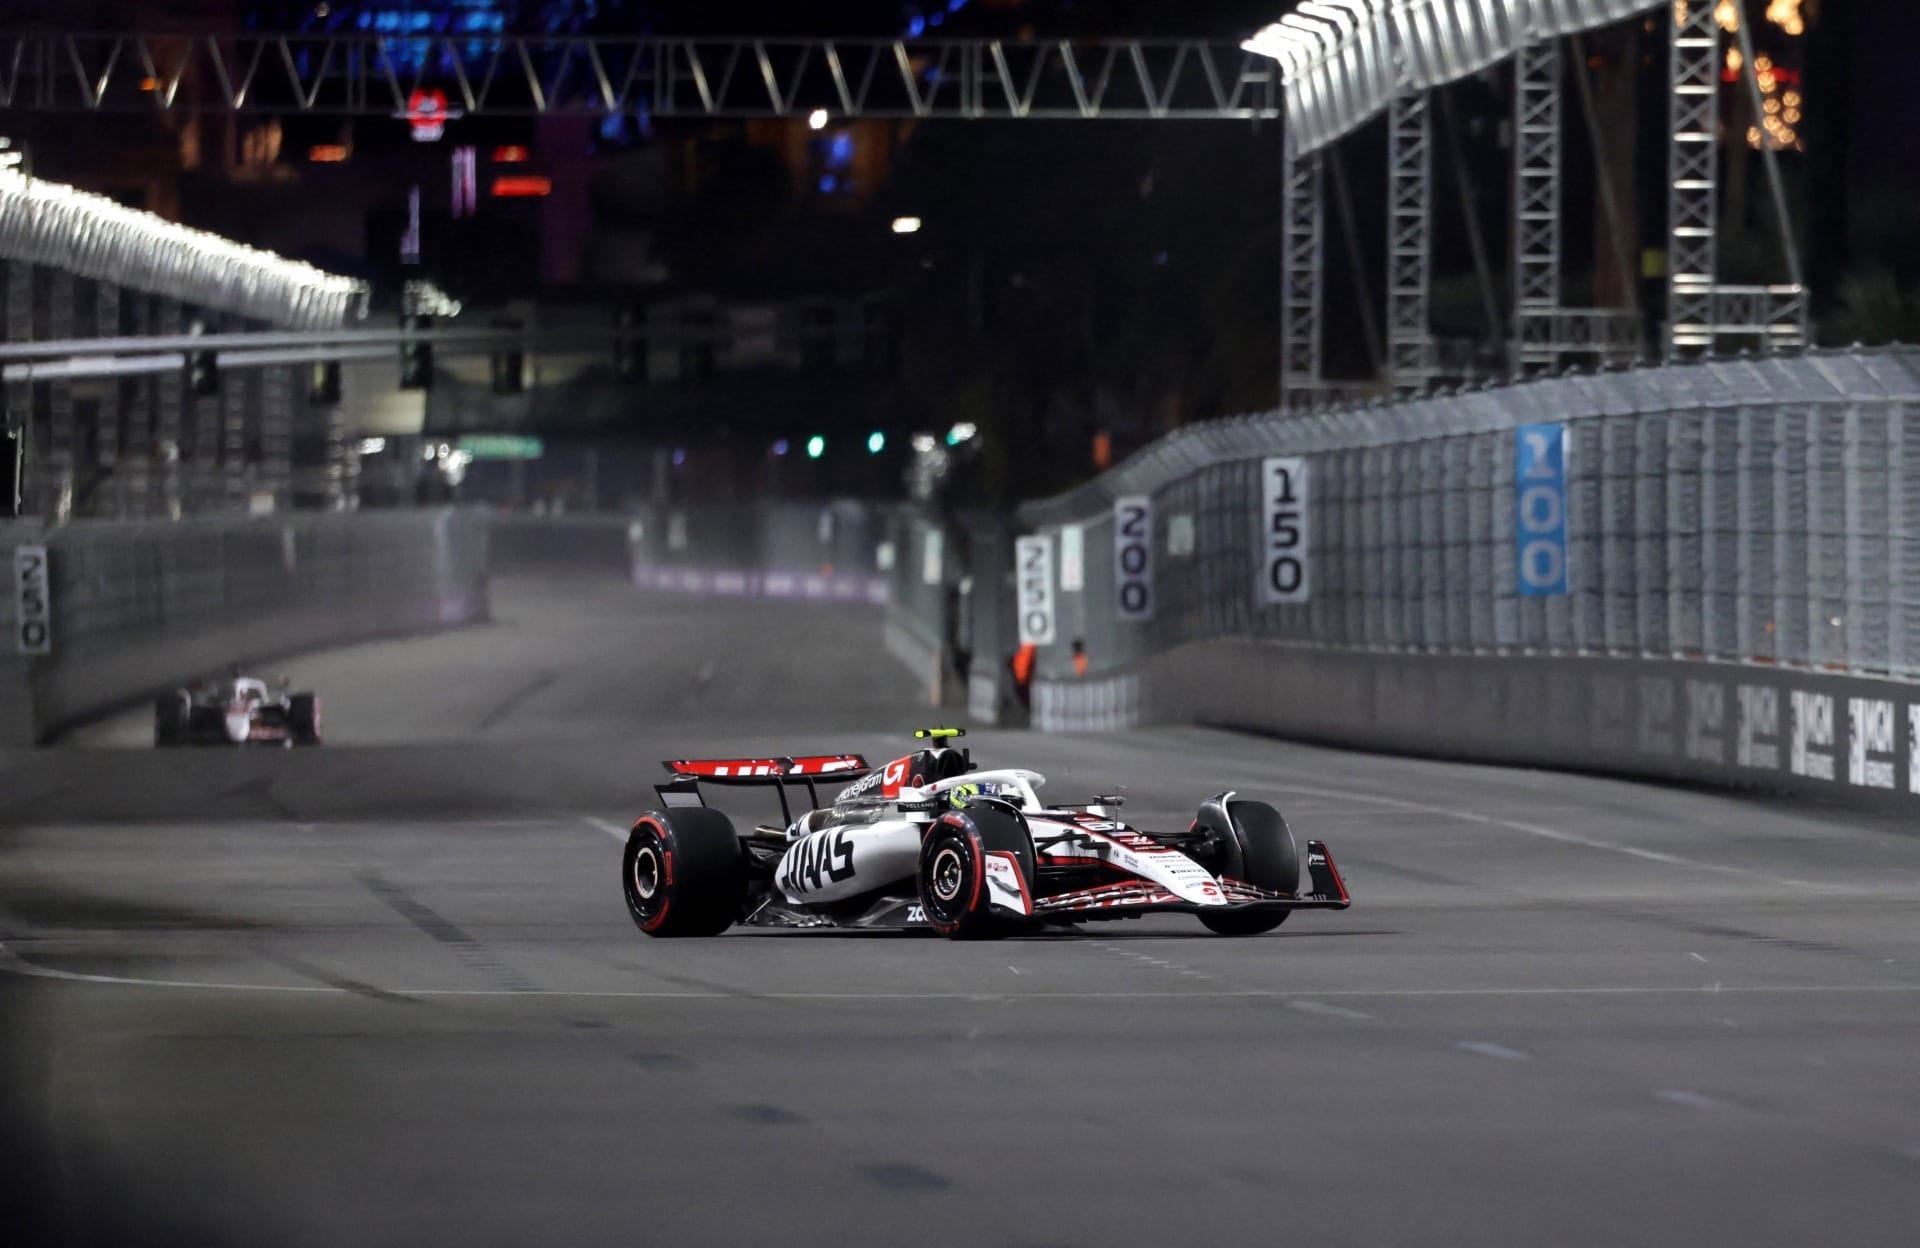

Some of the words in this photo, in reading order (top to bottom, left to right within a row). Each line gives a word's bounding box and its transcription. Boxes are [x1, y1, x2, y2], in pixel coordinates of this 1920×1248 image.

[1119, 505, 1148, 615] 200
[1272, 468, 1302, 595] 150
[1521, 433, 1565, 587] 100
[21, 557, 45, 647] 250
[1024, 543, 1048, 637] 250
